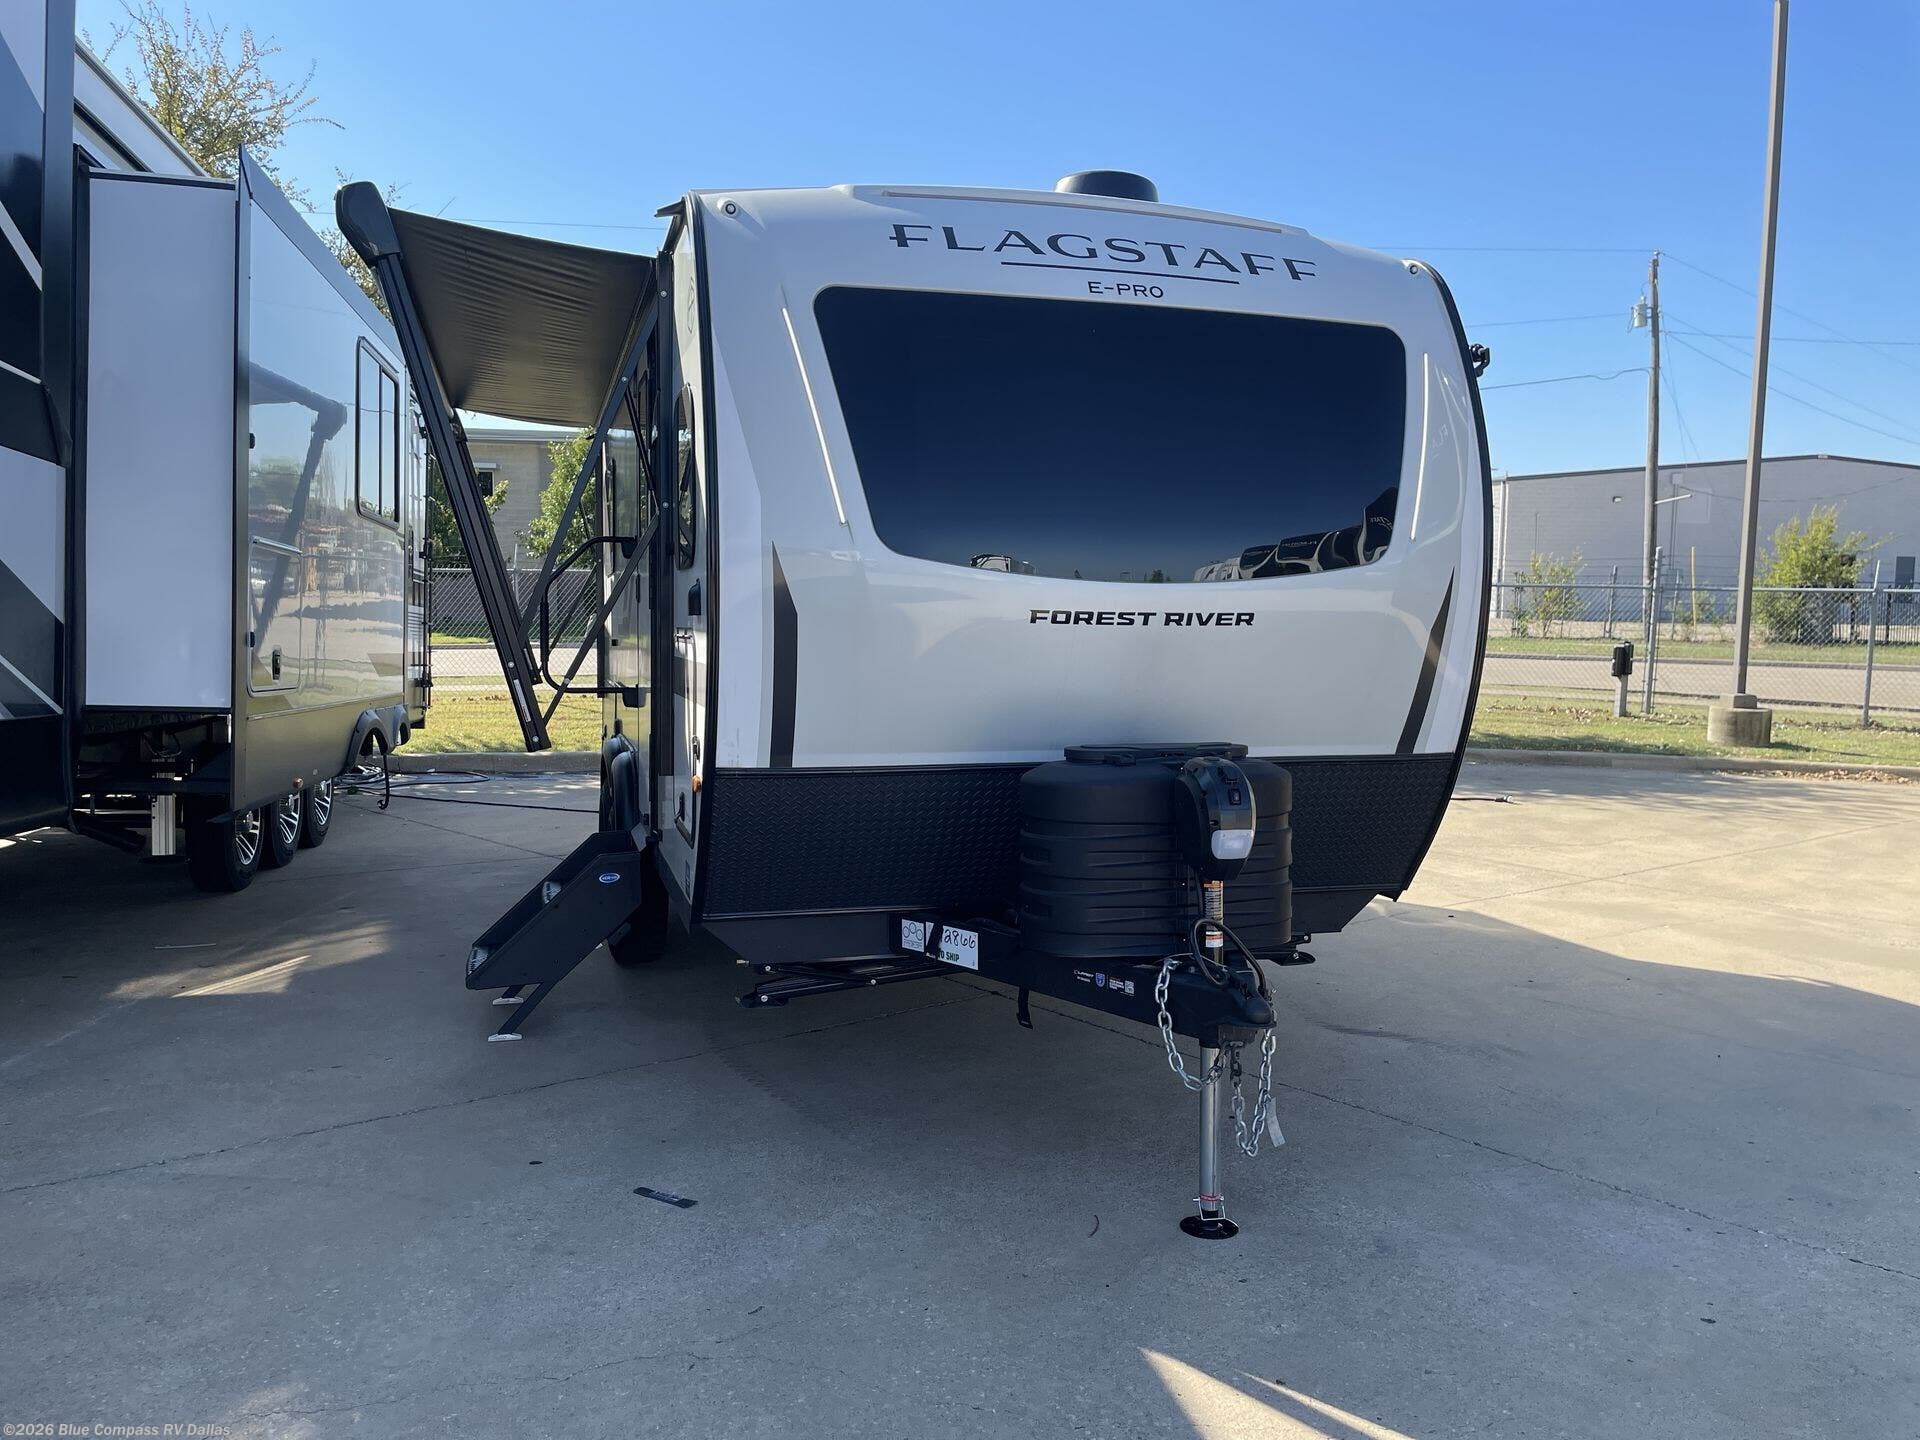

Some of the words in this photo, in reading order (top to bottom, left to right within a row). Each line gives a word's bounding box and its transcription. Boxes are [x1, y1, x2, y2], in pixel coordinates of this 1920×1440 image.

[889, 223, 1318, 281] FLAGSTAFF
[1087, 280, 1165, 299] E-PRO
[1029, 609, 1157, 626] FOREST
[1163, 612, 1256, 627] RIVER
[940, 929, 976, 949] 2866
[945, 951, 960, 962] SHIP
